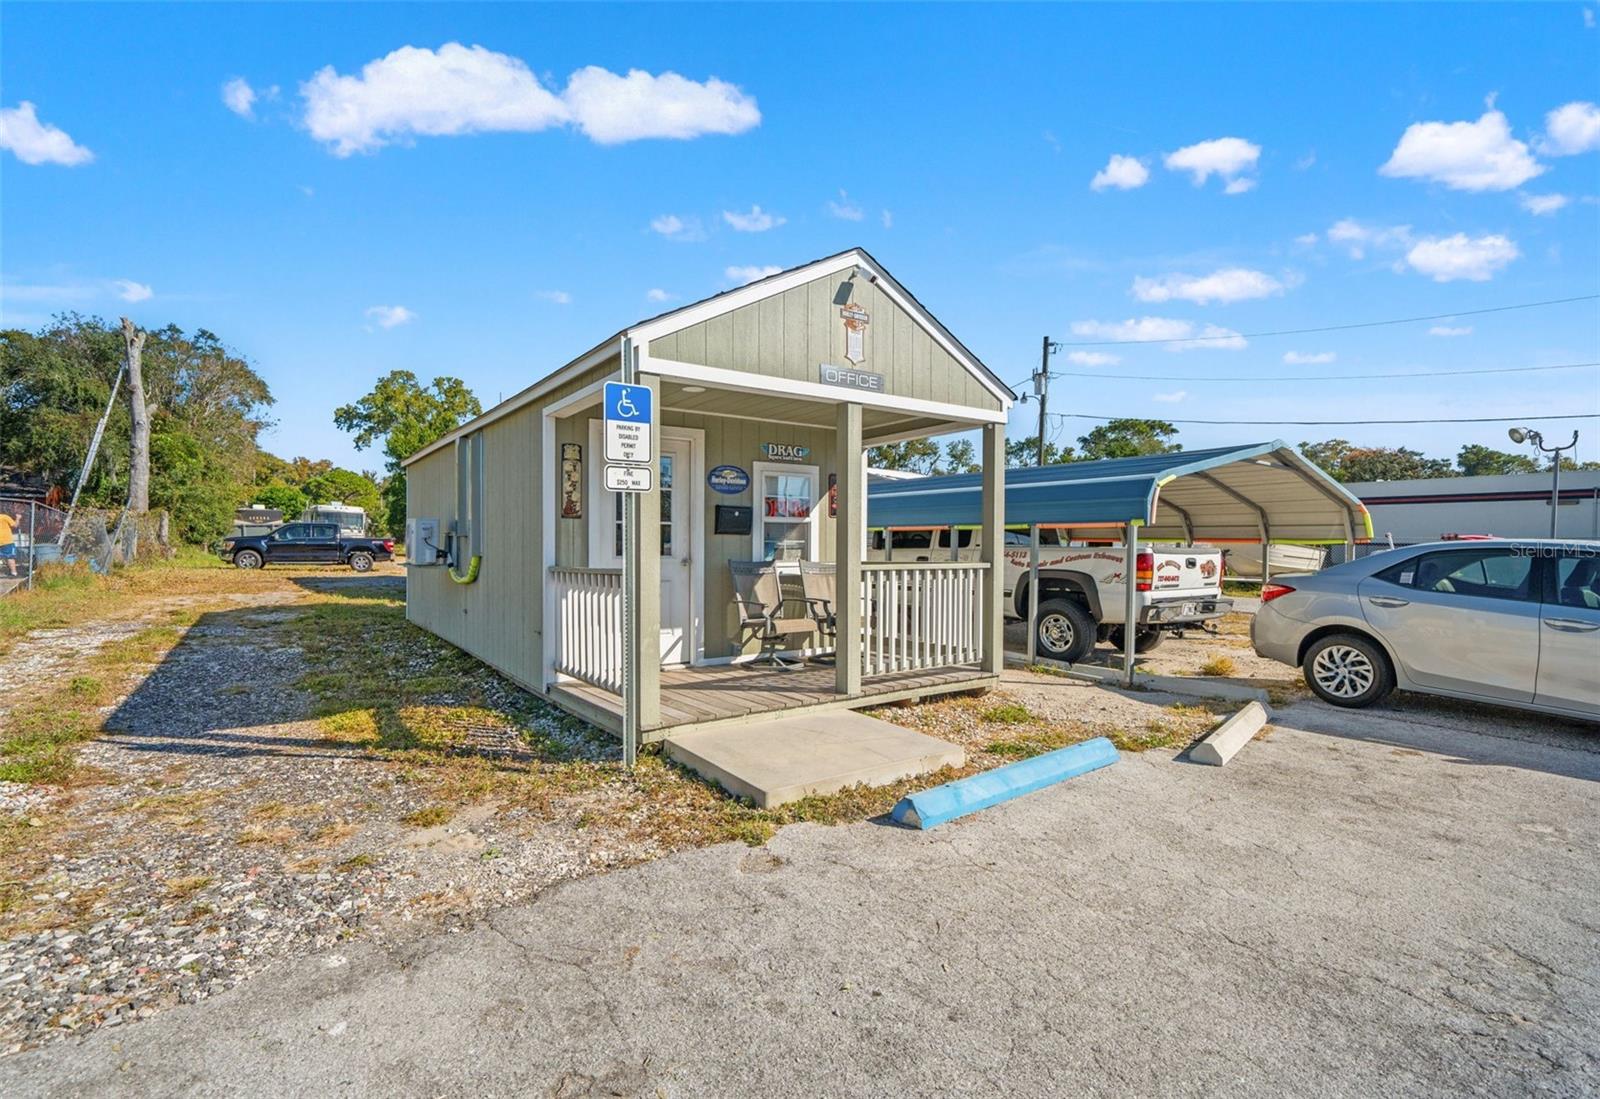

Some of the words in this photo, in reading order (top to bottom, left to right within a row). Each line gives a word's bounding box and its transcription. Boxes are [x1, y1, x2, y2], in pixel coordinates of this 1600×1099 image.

[826, 369, 878, 388] OFFICE
[618, 433, 639, 441] DISABLED
[768, 443, 802, 456] DRAG
[1049, 557, 1065, 567] and
